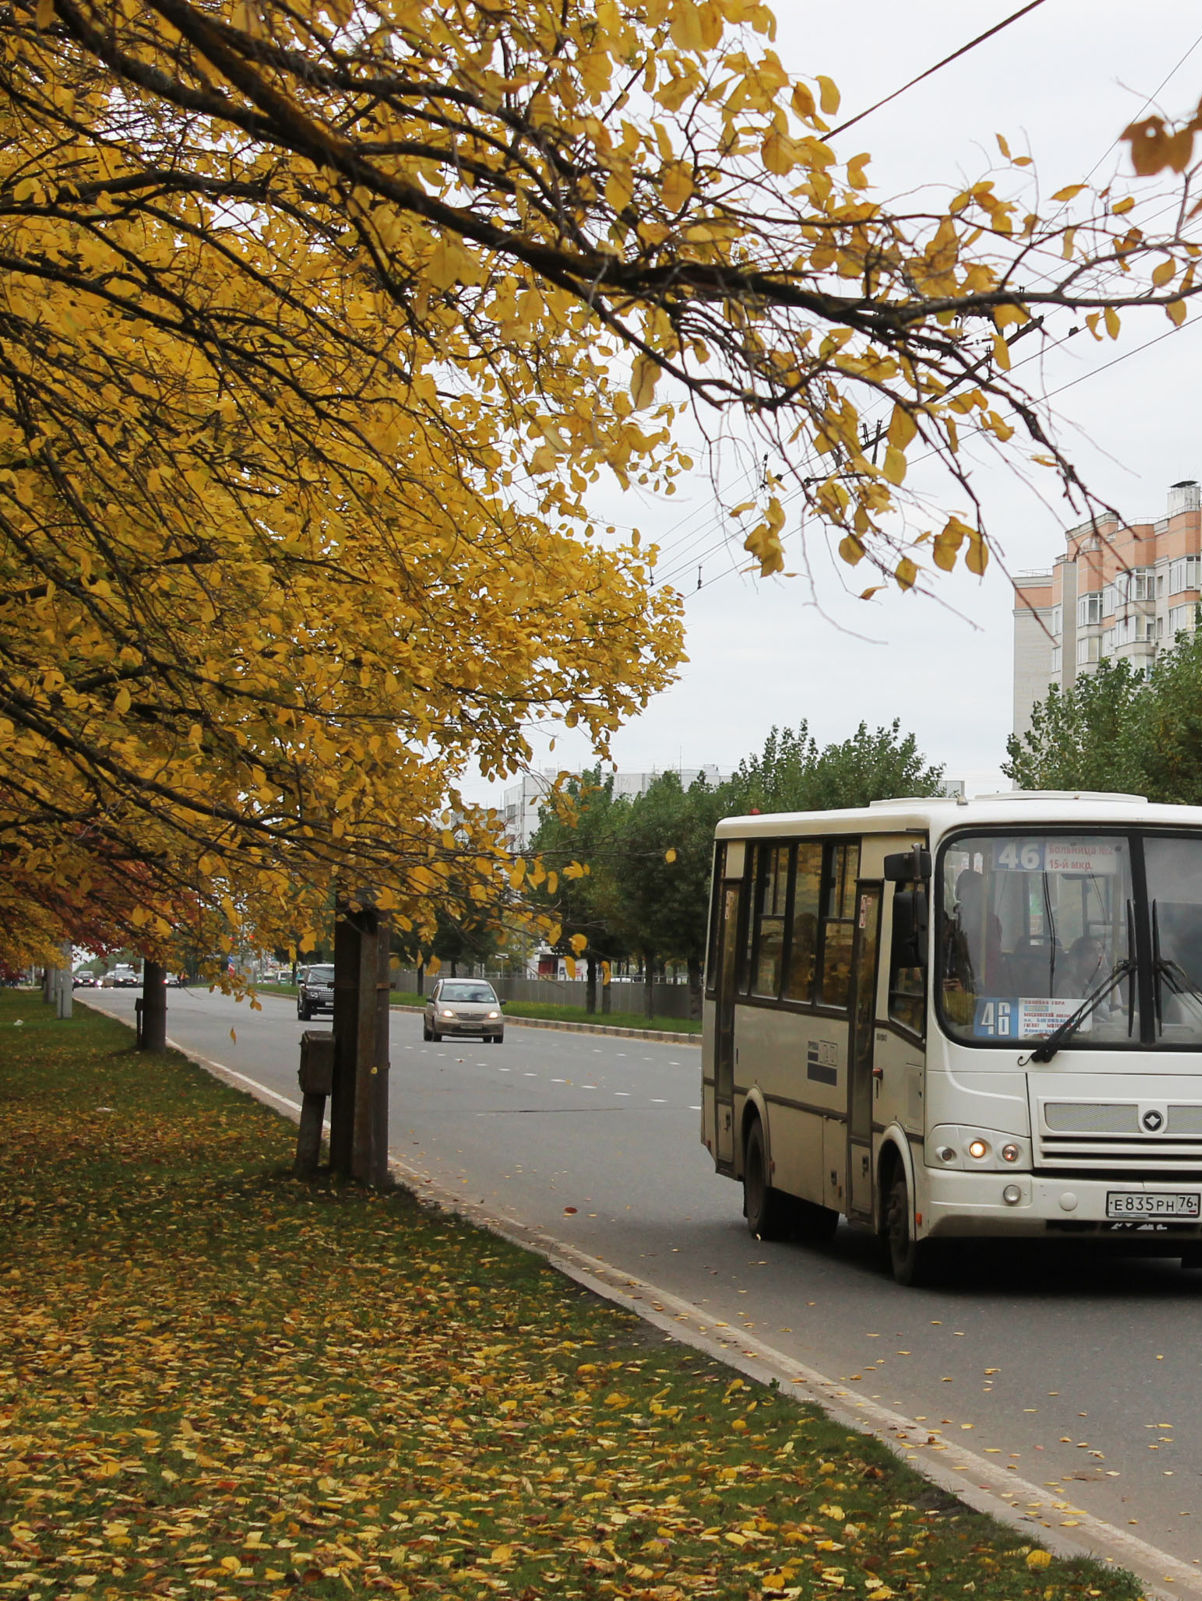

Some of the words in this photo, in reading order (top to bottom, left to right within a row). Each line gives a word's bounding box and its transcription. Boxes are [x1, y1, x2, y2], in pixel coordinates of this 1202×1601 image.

[998, 842, 1040, 870] 46
[981, 1001, 1011, 1036] 46
[1179, 1197, 1194, 1208] 76
